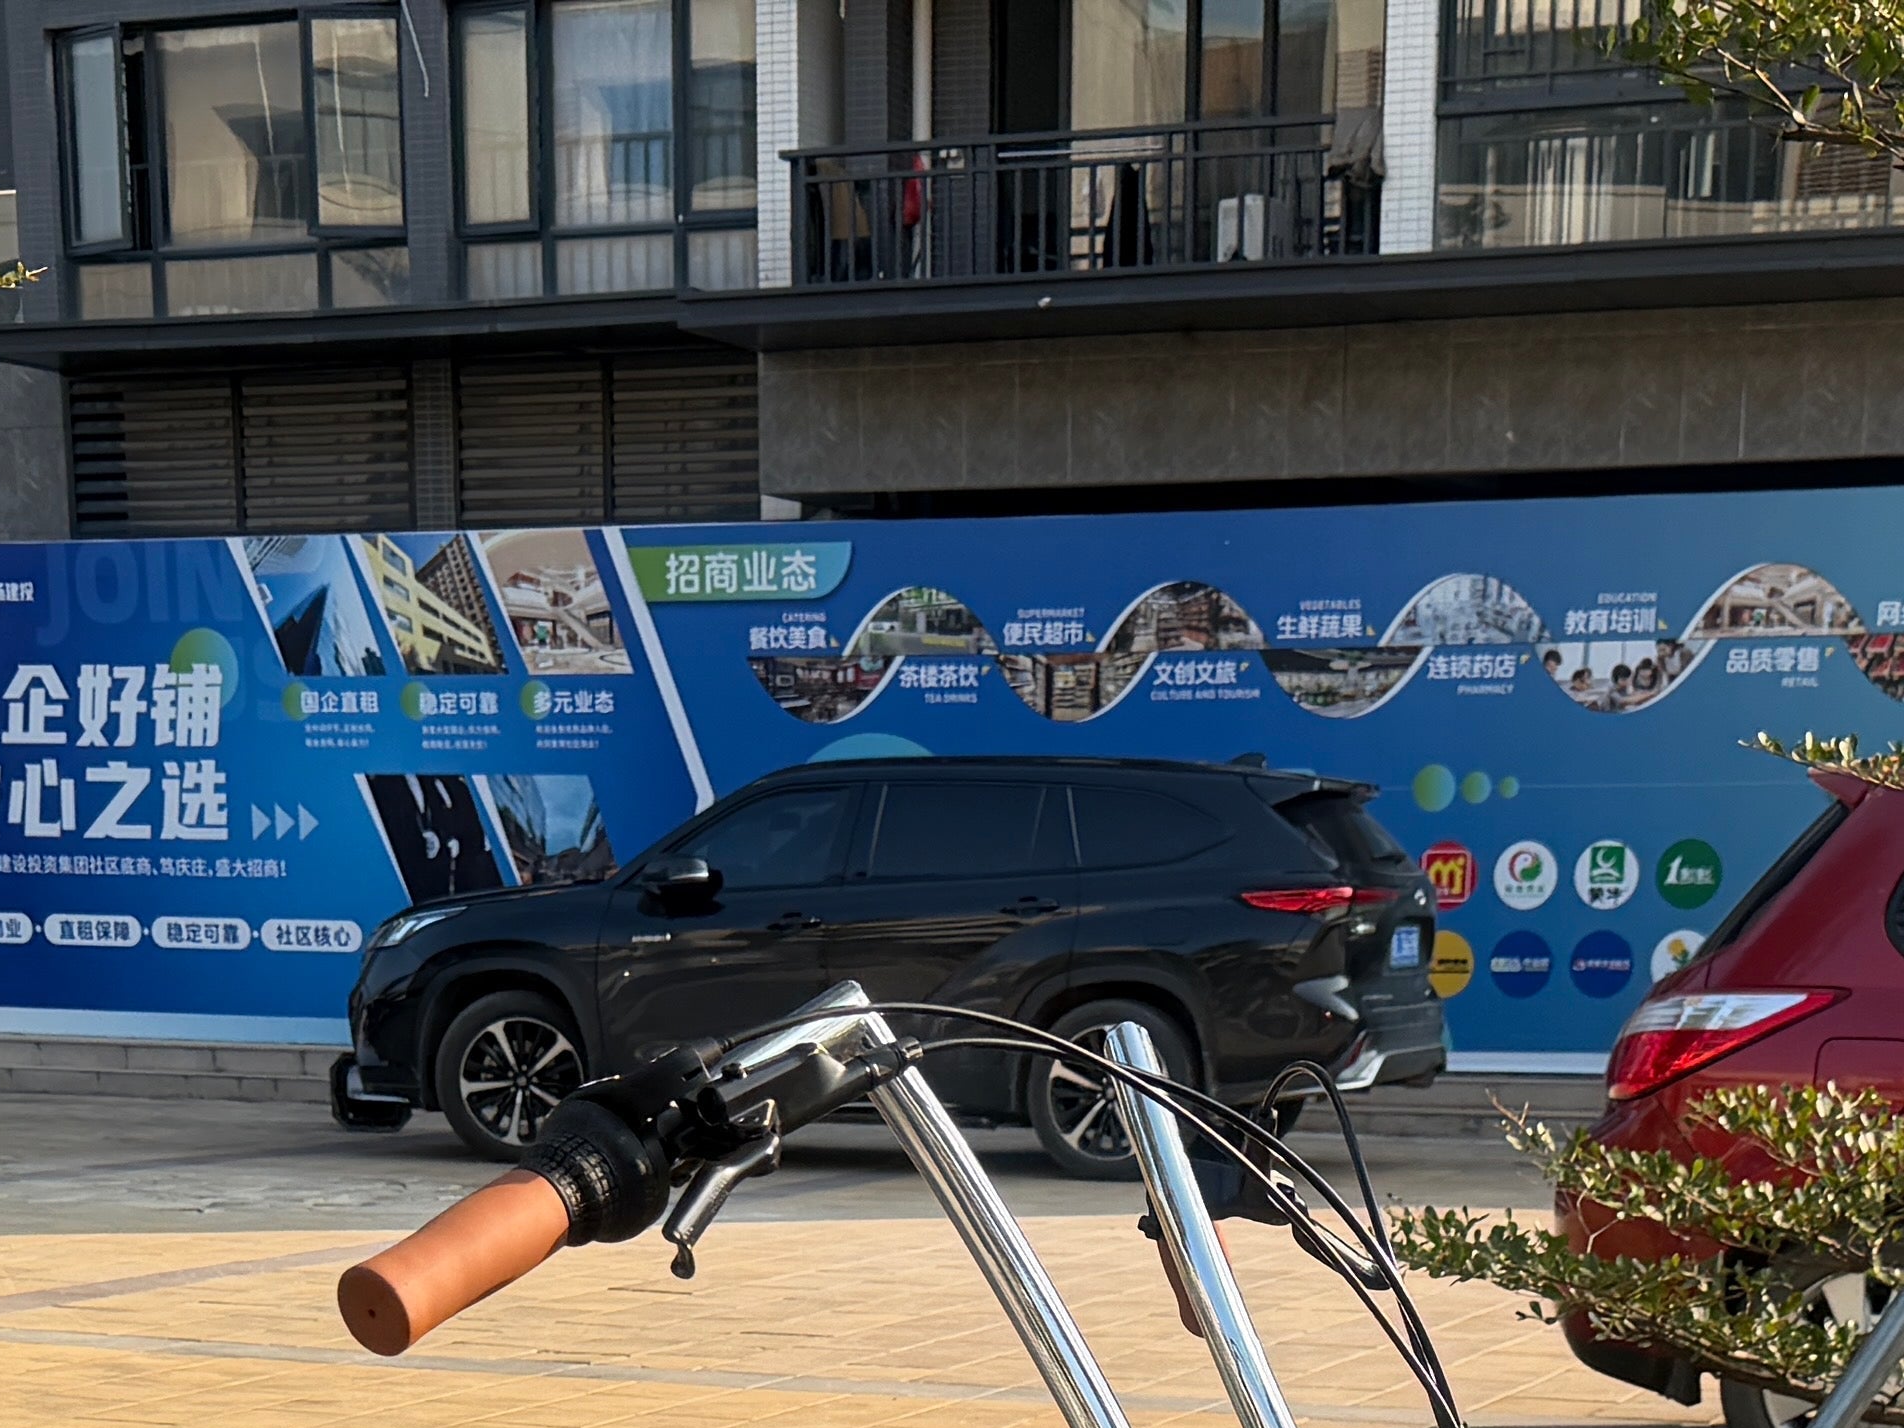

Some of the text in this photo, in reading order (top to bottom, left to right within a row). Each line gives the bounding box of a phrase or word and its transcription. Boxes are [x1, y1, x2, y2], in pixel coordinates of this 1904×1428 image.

[666, 549, 817, 595] 招商业态
[1597, 592, 1658, 605] EDUCATION
[1002, 622, 1085, 647] 便民超市
[1276, 615, 1363, 640] 生鲜蔬果
[1564, 608, 1656, 636] 教育培训
[749, 626, 827, 651] 餐饮美食
[1426, 653, 1517, 681] 连锁药店
[1725, 647, 1820, 675] 品质零售
[899, 664, 980, 689] 茶楼茶饮
[1152, 661, 1238, 687] 文创文旅
[300, 691, 380, 715] 国企直租
[419, 691, 499, 716] 稳定可靠
[533, 690, 615, 715] 多元业态
[59, 919, 131, 941] 直租保障
[166, 921, 240, 944] 稳定可靠
[276, 925, 352, 947] 社区核心
